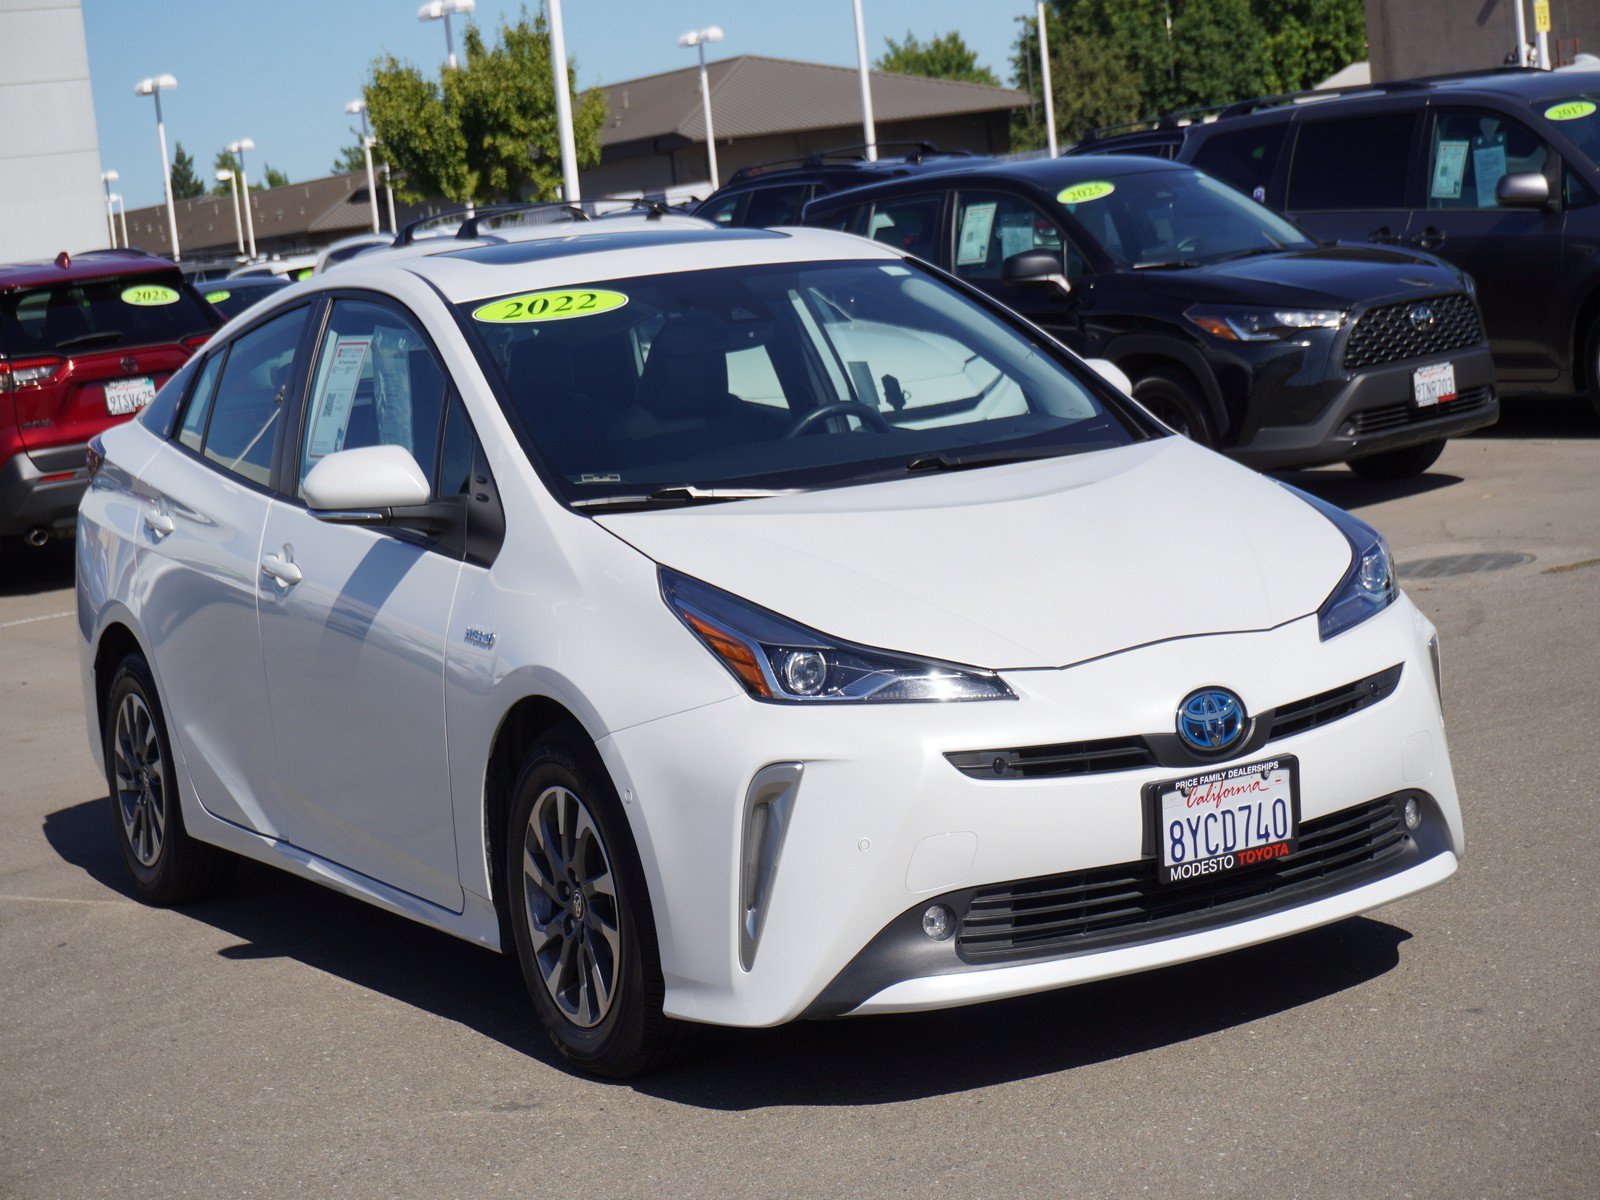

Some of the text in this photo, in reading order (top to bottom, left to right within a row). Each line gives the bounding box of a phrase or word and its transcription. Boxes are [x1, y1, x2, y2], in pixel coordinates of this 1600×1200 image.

[1557, 103, 1586, 119] 2017
[1068, 184, 1105, 202] 2025
[134, 290, 169, 303] 2025
[502, 293, 598, 320] 2022
[1175, 760, 1279, 791] PRICE FAMILY DEALERSHIPS
[1186, 776, 1270, 809] California
[1169, 798, 1288, 863] 8YCD740
[1170, 843, 1290, 882] MODESTO TOYOTA
